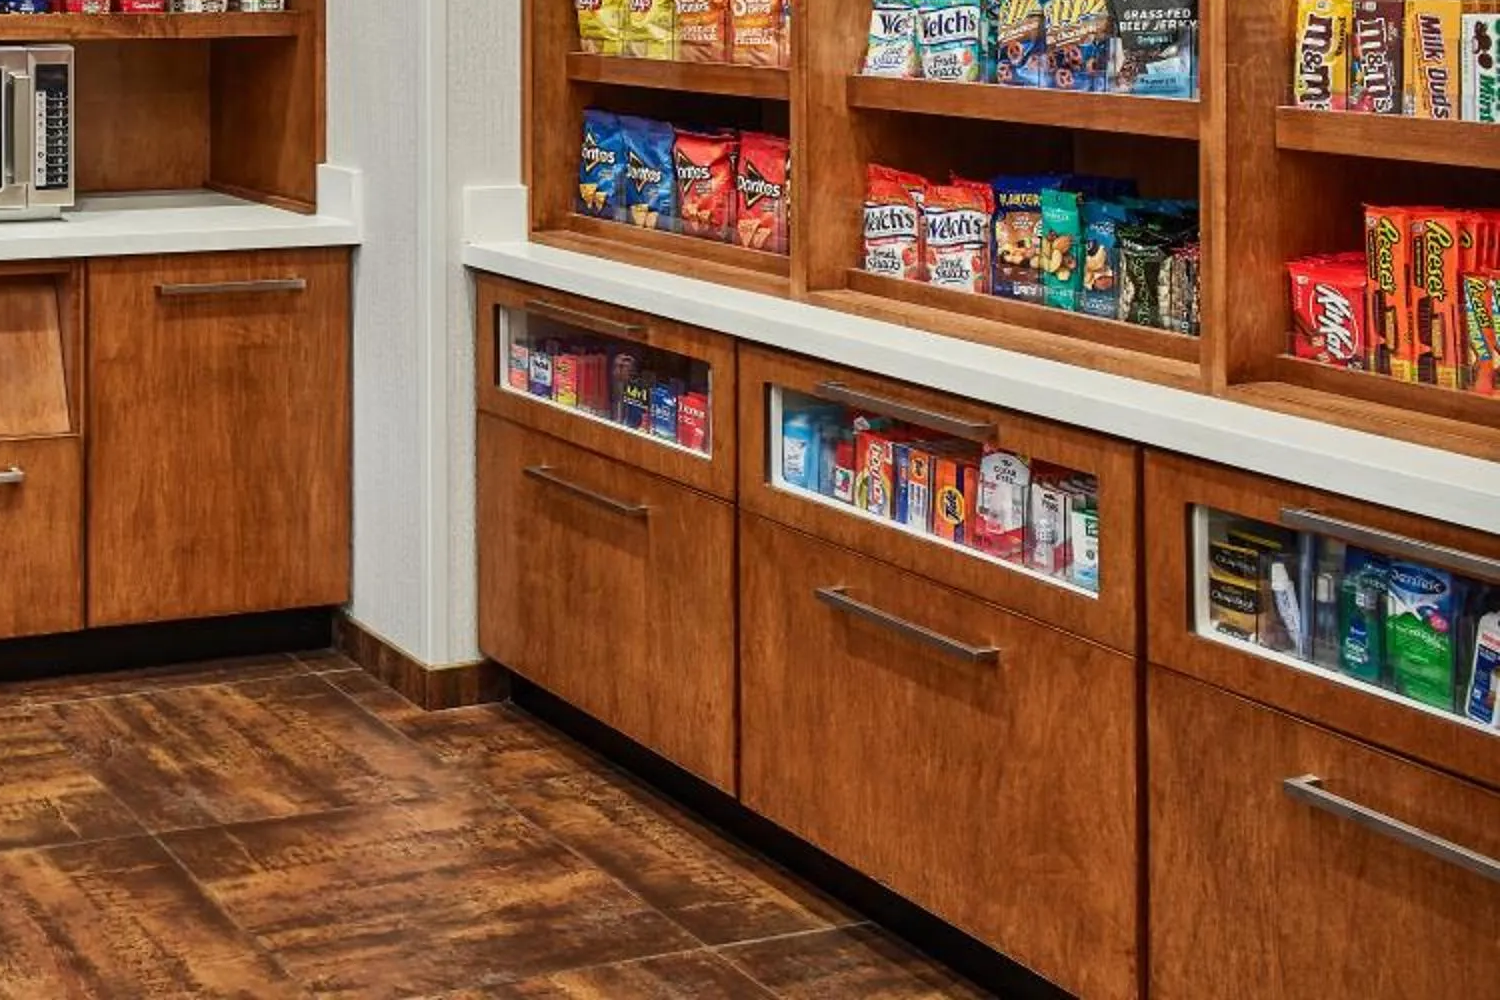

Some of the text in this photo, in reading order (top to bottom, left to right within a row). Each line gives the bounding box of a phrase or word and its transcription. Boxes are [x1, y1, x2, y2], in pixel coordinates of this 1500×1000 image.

[1420, 15, 1453, 119] Milk Duds
[736, 175, 781, 198] Doritos
